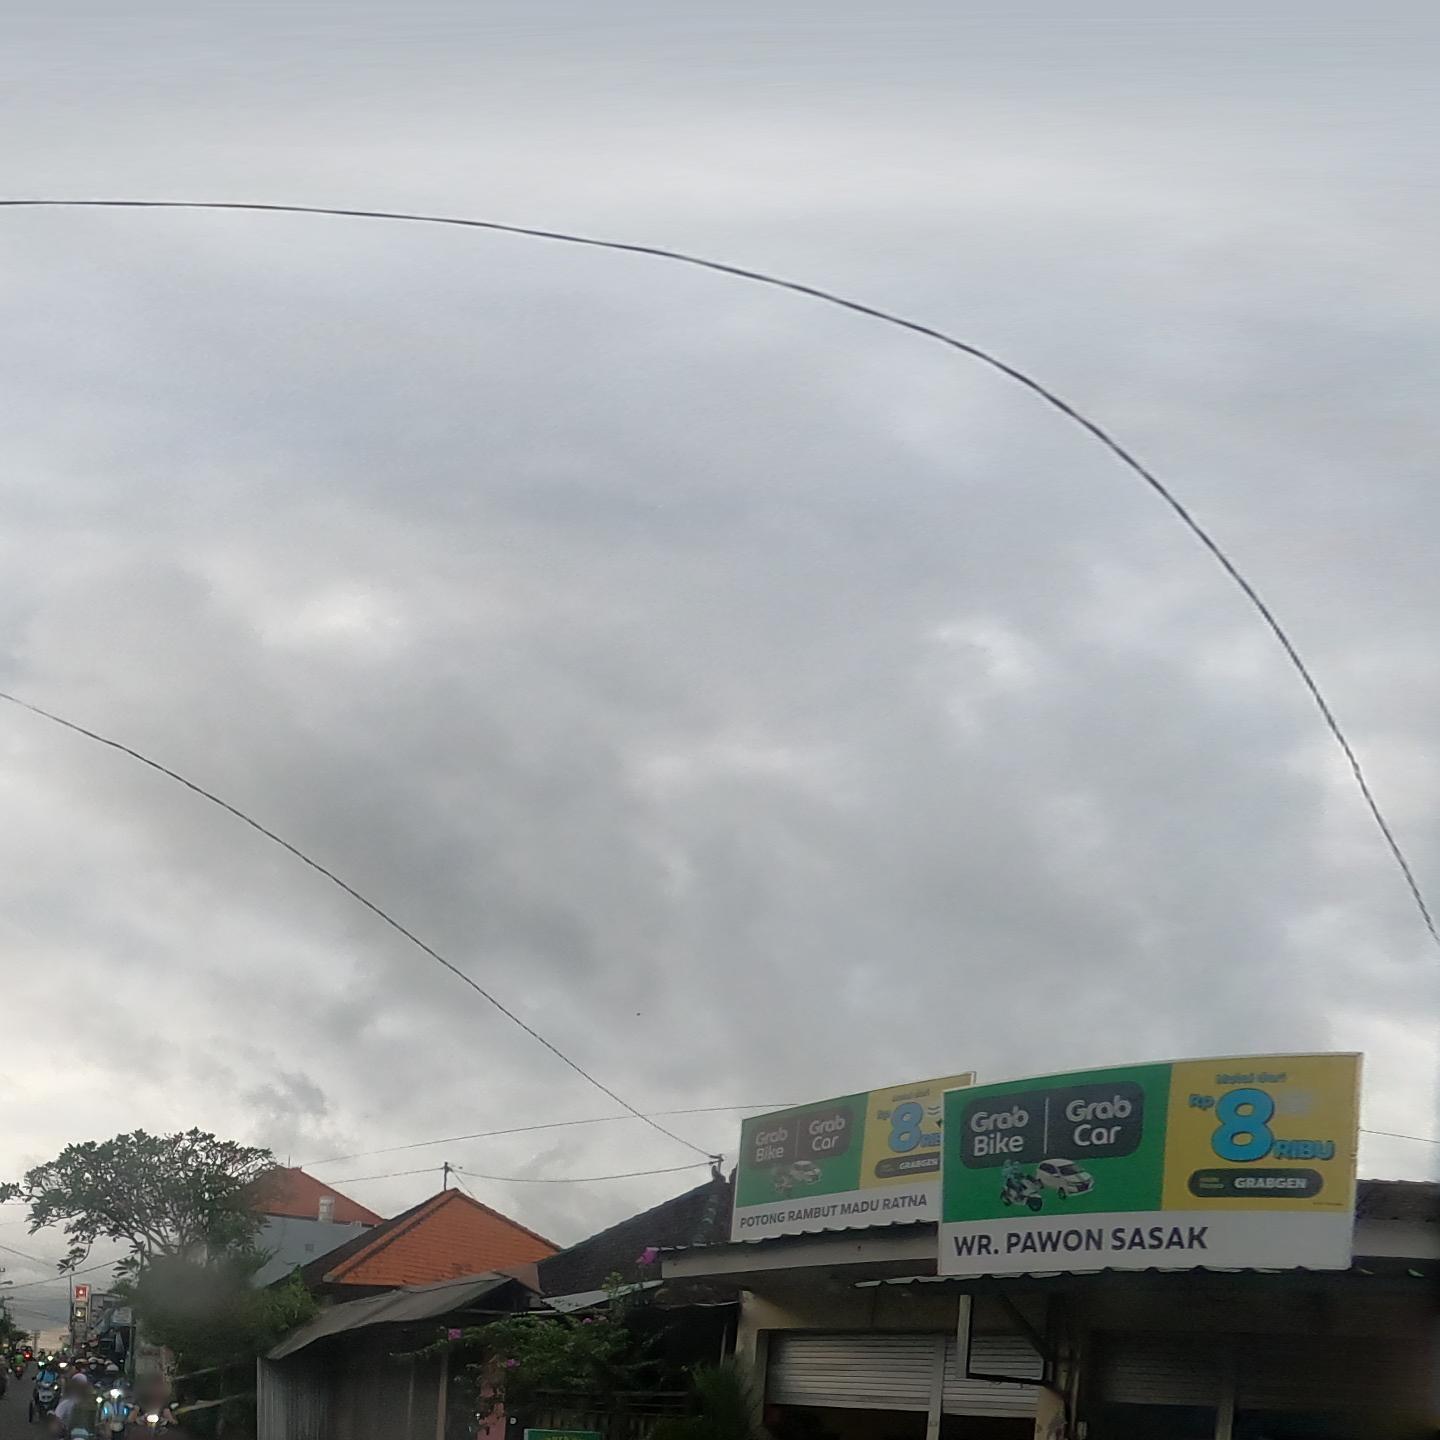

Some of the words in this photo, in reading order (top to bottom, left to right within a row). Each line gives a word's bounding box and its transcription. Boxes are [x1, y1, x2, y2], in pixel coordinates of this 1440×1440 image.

[970, 1105, 1029, 1133] Grab
[1065, 1095, 1132, 1122] Grab
[756, 1127, 788, 1146] Grab
[809, 1115, 845, 1135] Grab
[888, 1102, 923, 1154] 8
[1074, 1124, 1122, 1146] Car
[1211, 1087, 1274, 1163] 8
[1272, 1139, 1336, 1160] RIBU
[756, 1146, 784, 1162] Bike
[812, 1134, 839, 1151] Car
[974, 1132, 1024, 1157] Bike
[1234, 1177, 1307, 1189] GRABGEN
[740, 1212, 785, 1228] POTONG
[788, 1205, 837, 1221] RAMBUT
[840, 1198, 879, 1215] MADU
[883, 1194, 927, 1210] RATNA
[954, 1234, 999, 1256] WR.
[1006, 1229, 1103, 1254] PAWON
[1111, 1226, 1208, 1251] SASAK
